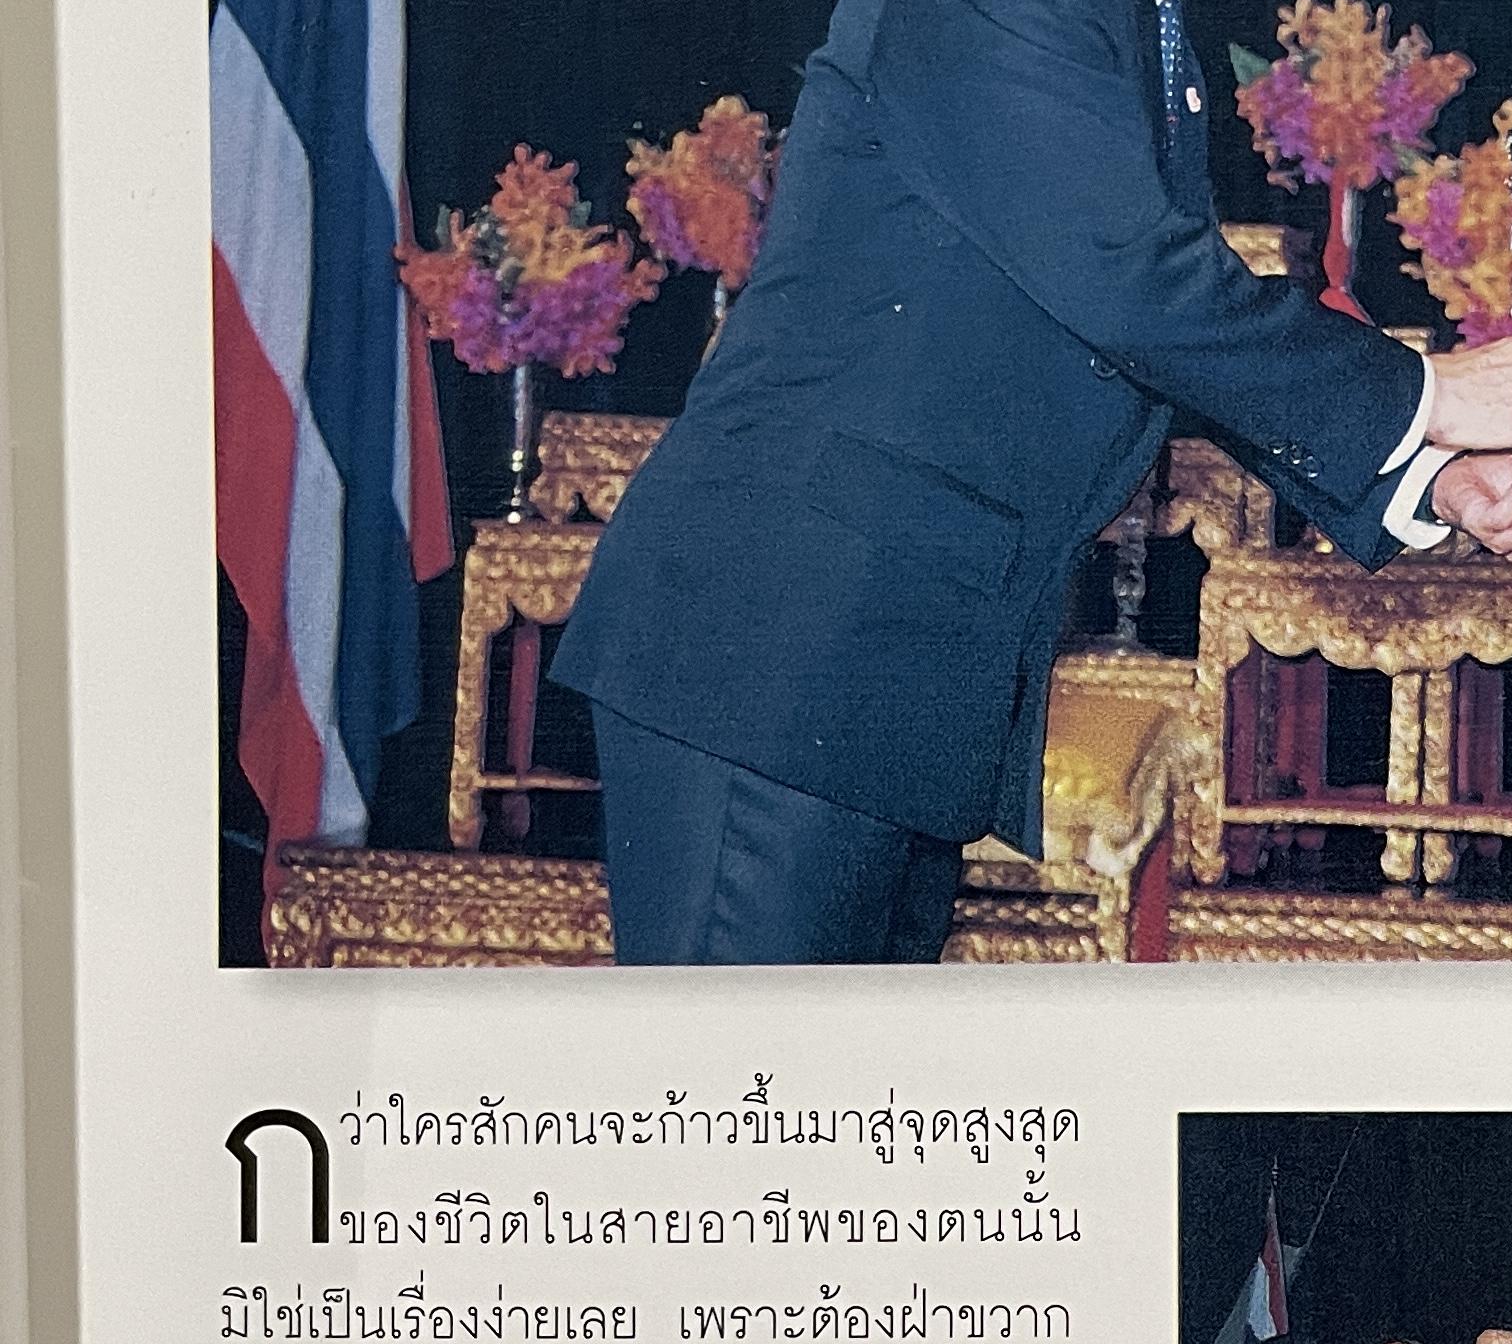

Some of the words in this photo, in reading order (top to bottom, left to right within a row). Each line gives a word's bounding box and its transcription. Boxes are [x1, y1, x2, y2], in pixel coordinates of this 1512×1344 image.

[339, 1169, 1081, 1245] ของชีวิตในสายอาชีพของตนนั้น
[220, 1268, 637, 1340] มิใช่เป็นเรื่องง่ายเลย
[680, 1282, 1070, 1340] เพราะต้องฝ่าขวาก
